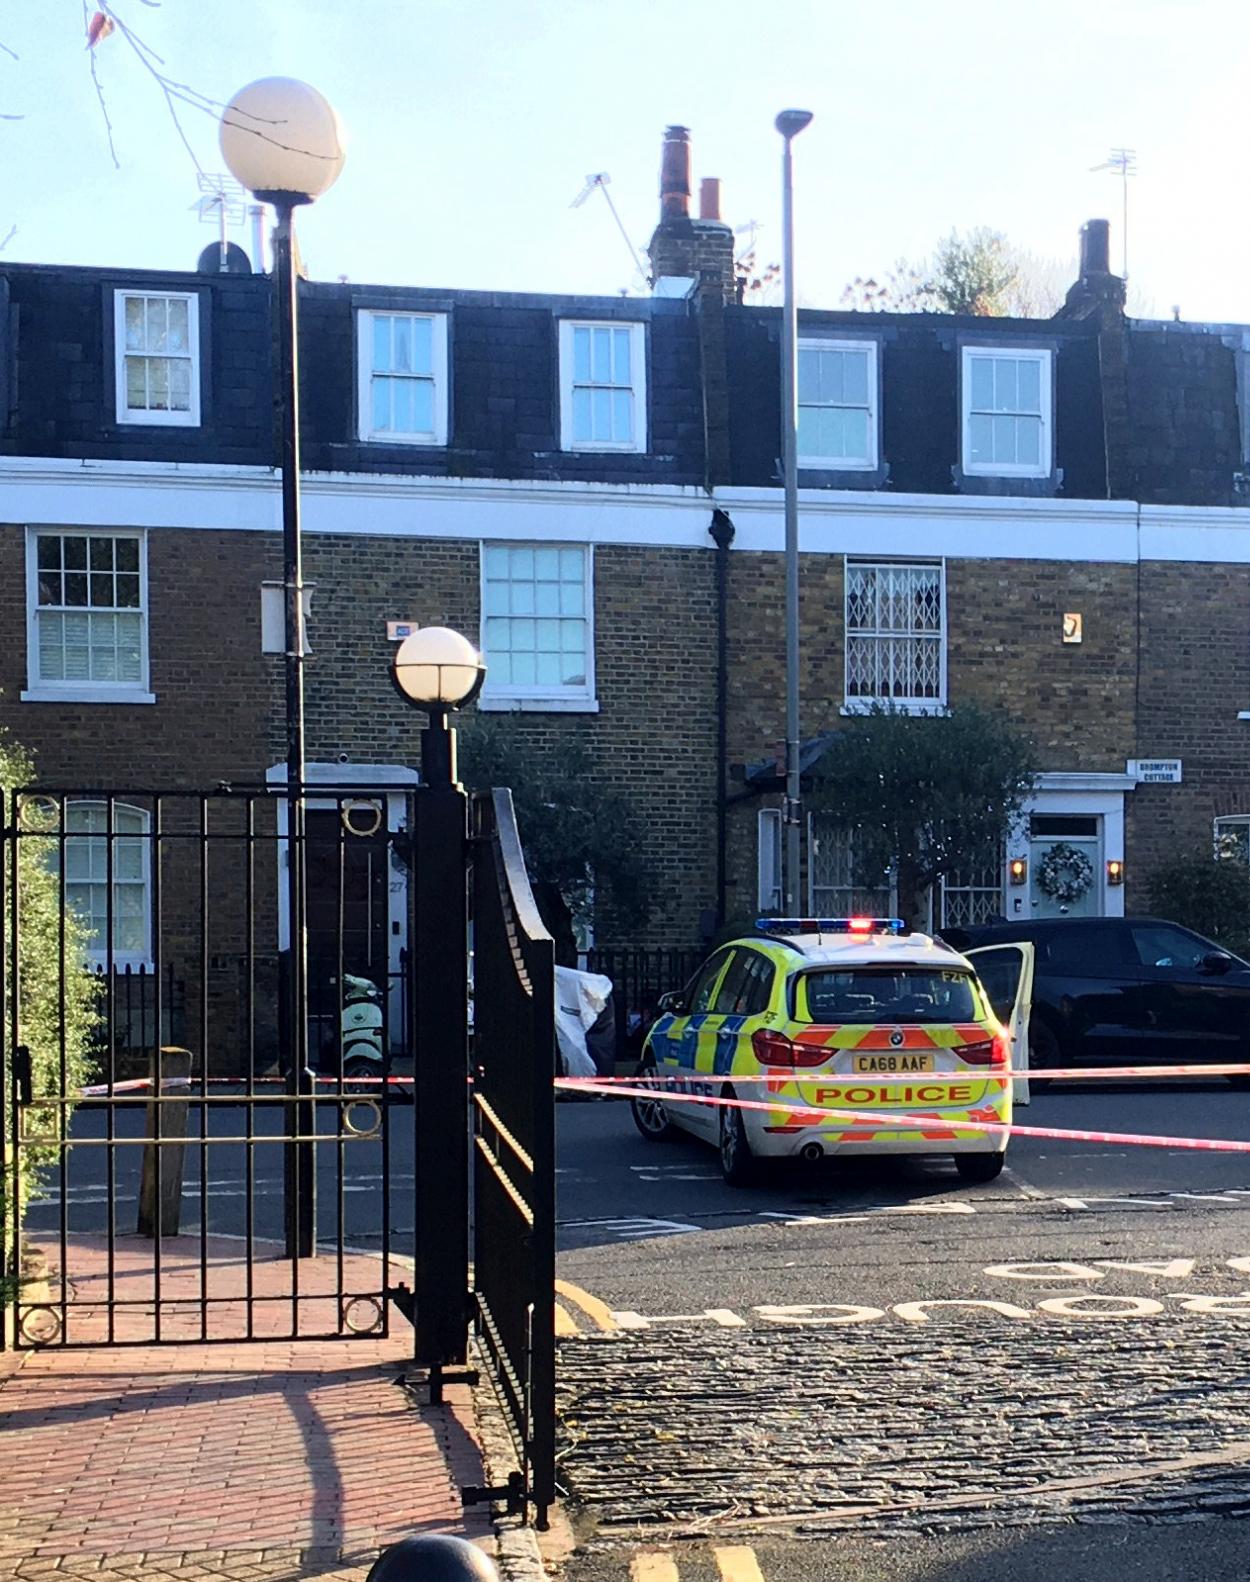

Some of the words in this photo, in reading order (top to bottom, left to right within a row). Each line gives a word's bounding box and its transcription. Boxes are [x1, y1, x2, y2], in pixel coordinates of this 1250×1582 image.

[390, 882, 404, 893] 27
[859, 1056, 897, 1071] CA68
[901, 1055, 928, 1070] AAF
[815, 1085, 972, 1104] POLICE
